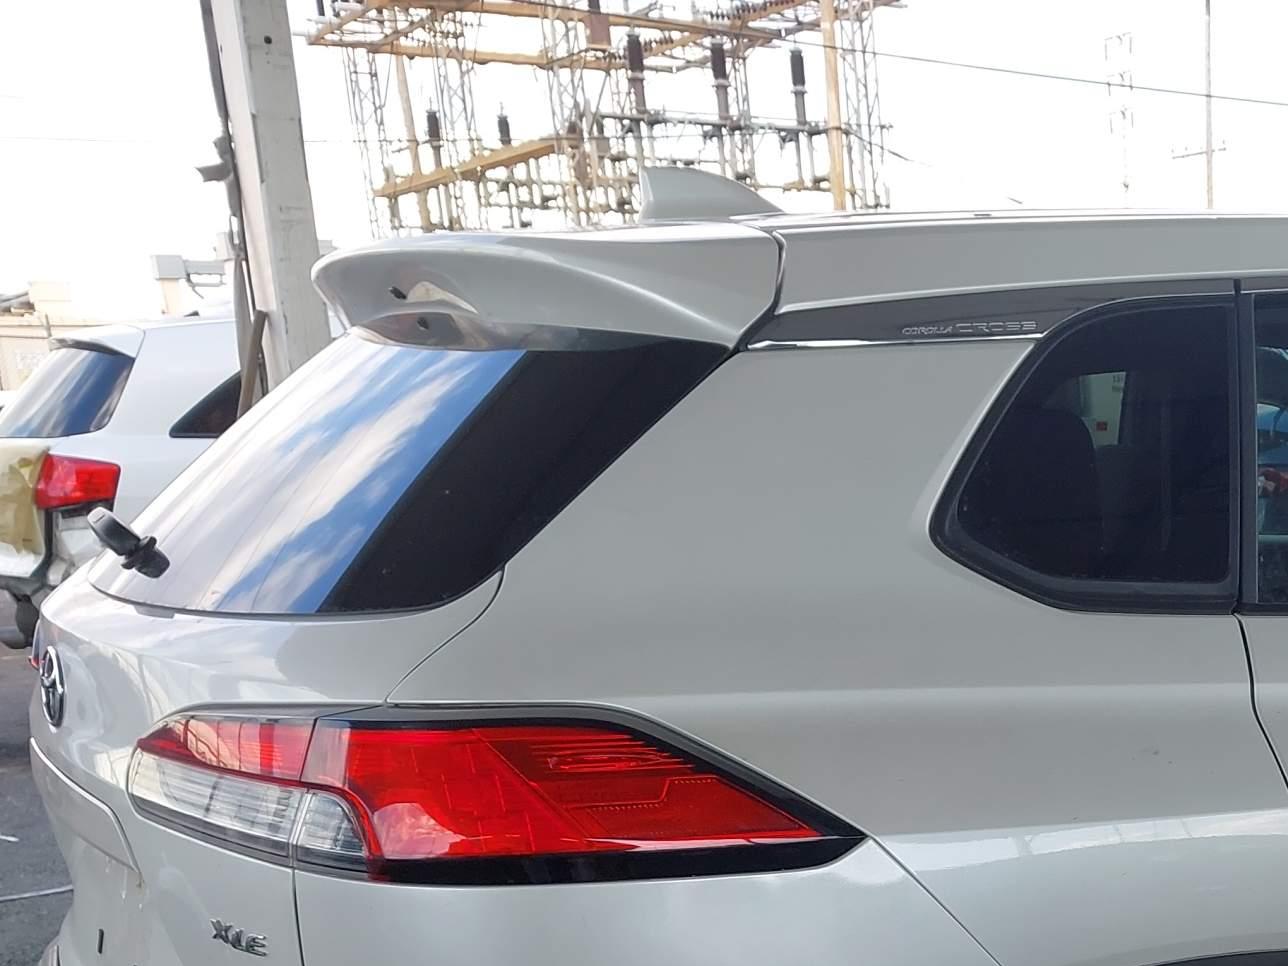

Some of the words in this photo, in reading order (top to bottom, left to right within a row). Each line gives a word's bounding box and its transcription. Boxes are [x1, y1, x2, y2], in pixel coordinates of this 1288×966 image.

[902, 325, 953, 335] COROLLA
[956, 320, 1037, 333] CROSS
[209, 918, 268, 957] XLE
